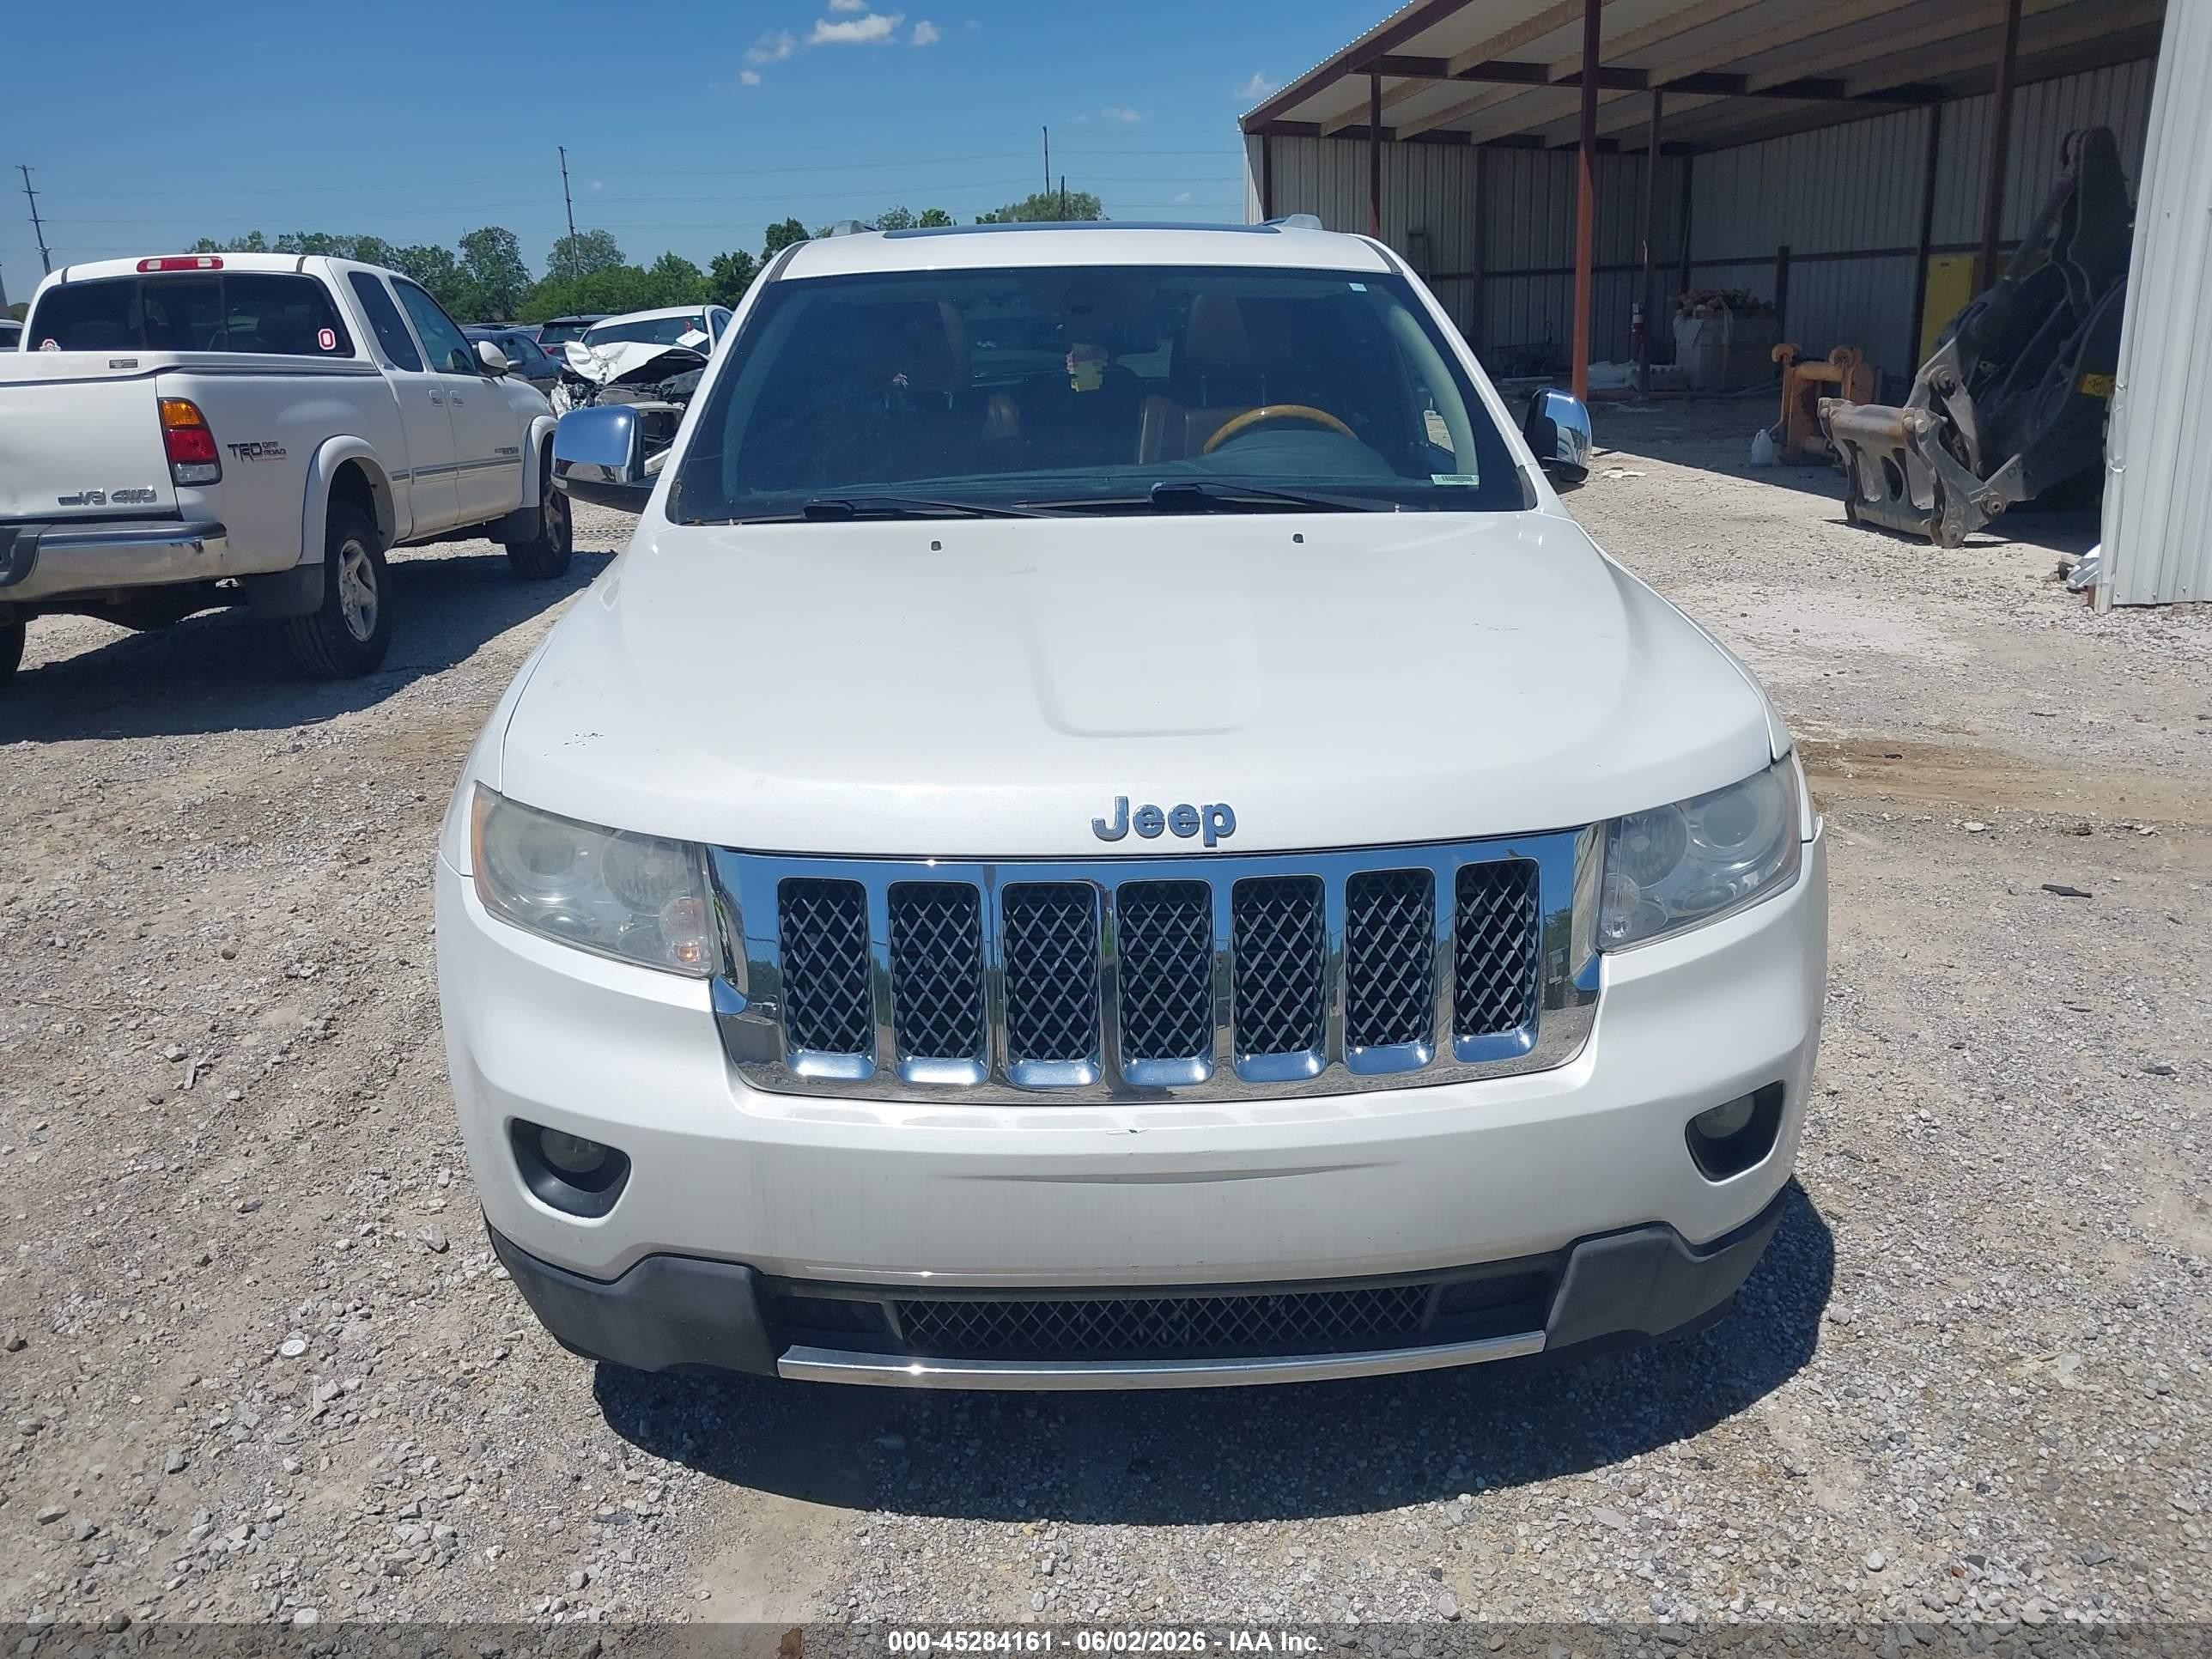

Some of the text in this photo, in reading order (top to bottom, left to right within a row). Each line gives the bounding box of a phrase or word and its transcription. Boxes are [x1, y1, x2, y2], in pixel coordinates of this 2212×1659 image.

[227, 442, 263, 462] TRD
[263, 448, 287, 457] ROAD
[111, 485, 157, 504] 4WD
[1091, 796, 1237, 848] Jeep
